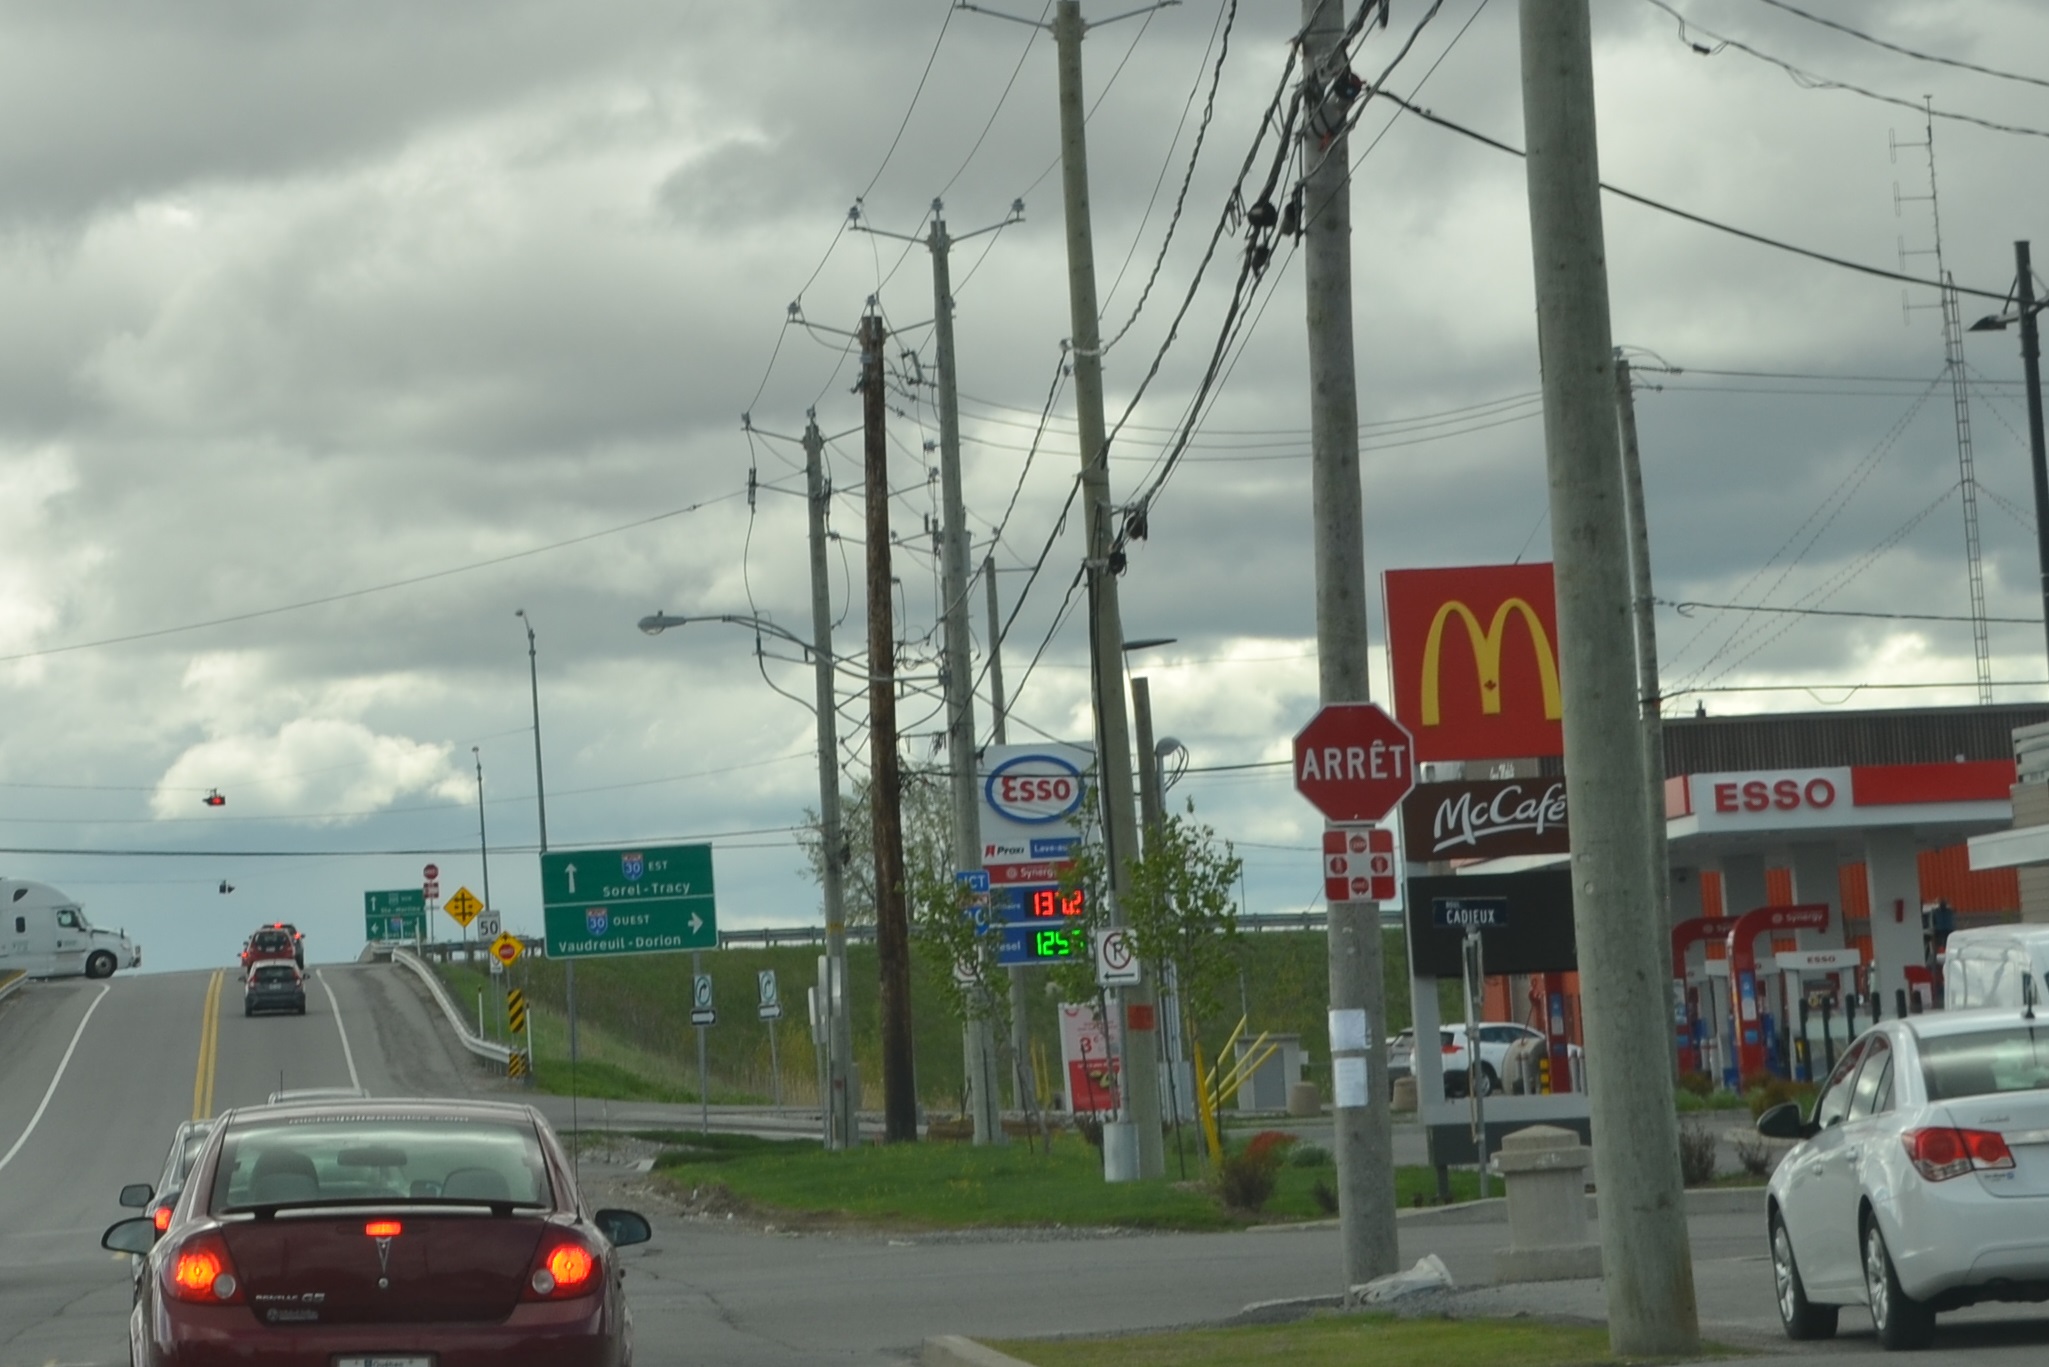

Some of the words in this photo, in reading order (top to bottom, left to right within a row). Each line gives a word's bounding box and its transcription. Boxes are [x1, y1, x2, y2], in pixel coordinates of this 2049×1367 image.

[1301, 739, 1405, 781] ARRÊT
[1714, 778, 1836, 813] ESSO
[1434, 782, 1567, 845] McCafé
[648, 860, 668, 872] EST
[589, 917, 606, 930] 30
[612, 914, 650, 927] OUEST
[1446, 909, 1496, 924] CADIEUX
[1786, 909, 1824, 923] Synergy
[480, 920, 499, 936] 50
[1807, 955, 1836, 964] ESSO
